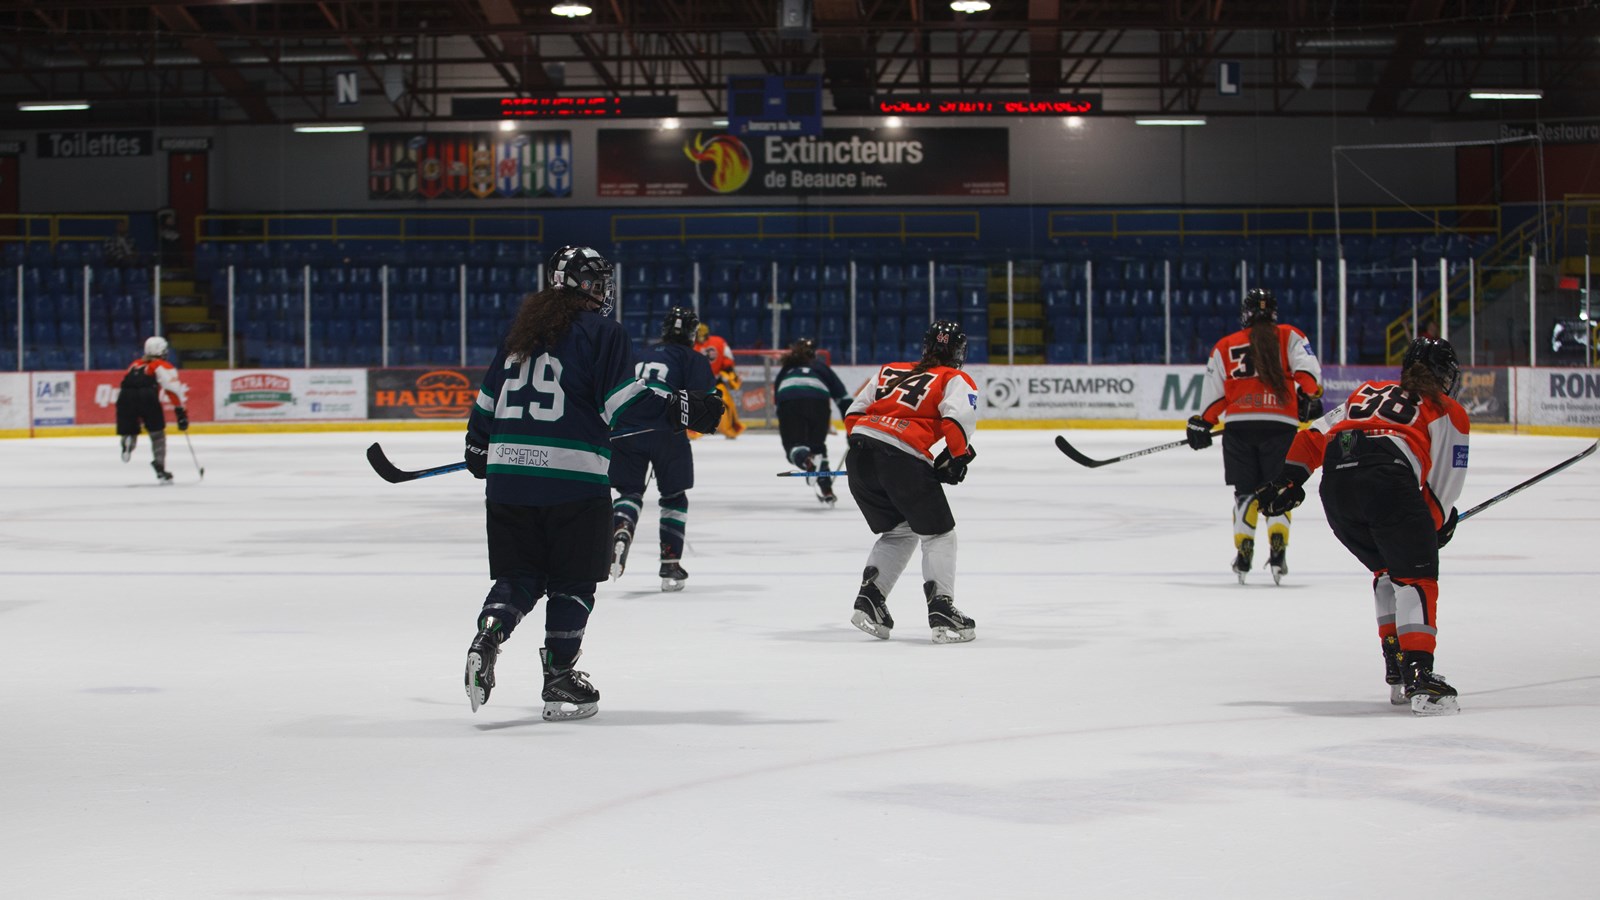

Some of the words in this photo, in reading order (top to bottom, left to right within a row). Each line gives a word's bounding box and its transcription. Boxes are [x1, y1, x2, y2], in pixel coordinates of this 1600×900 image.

[337, 73, 358, 102] N
[1220, 64, 1237, 94] L
[49, 134, 141, 157] Toilettes
[764, 135, 924, 165] Extincteurs
[764, 171, 787, 189] de
[791, 170, 857, 189] Beauce
[861, 172, 887, 188] inc.
[494, 352, 565, 422] 29
[1028, 378, 1135, 394] ESTAMPRO
[1346, 383, 1424, 427] 38
